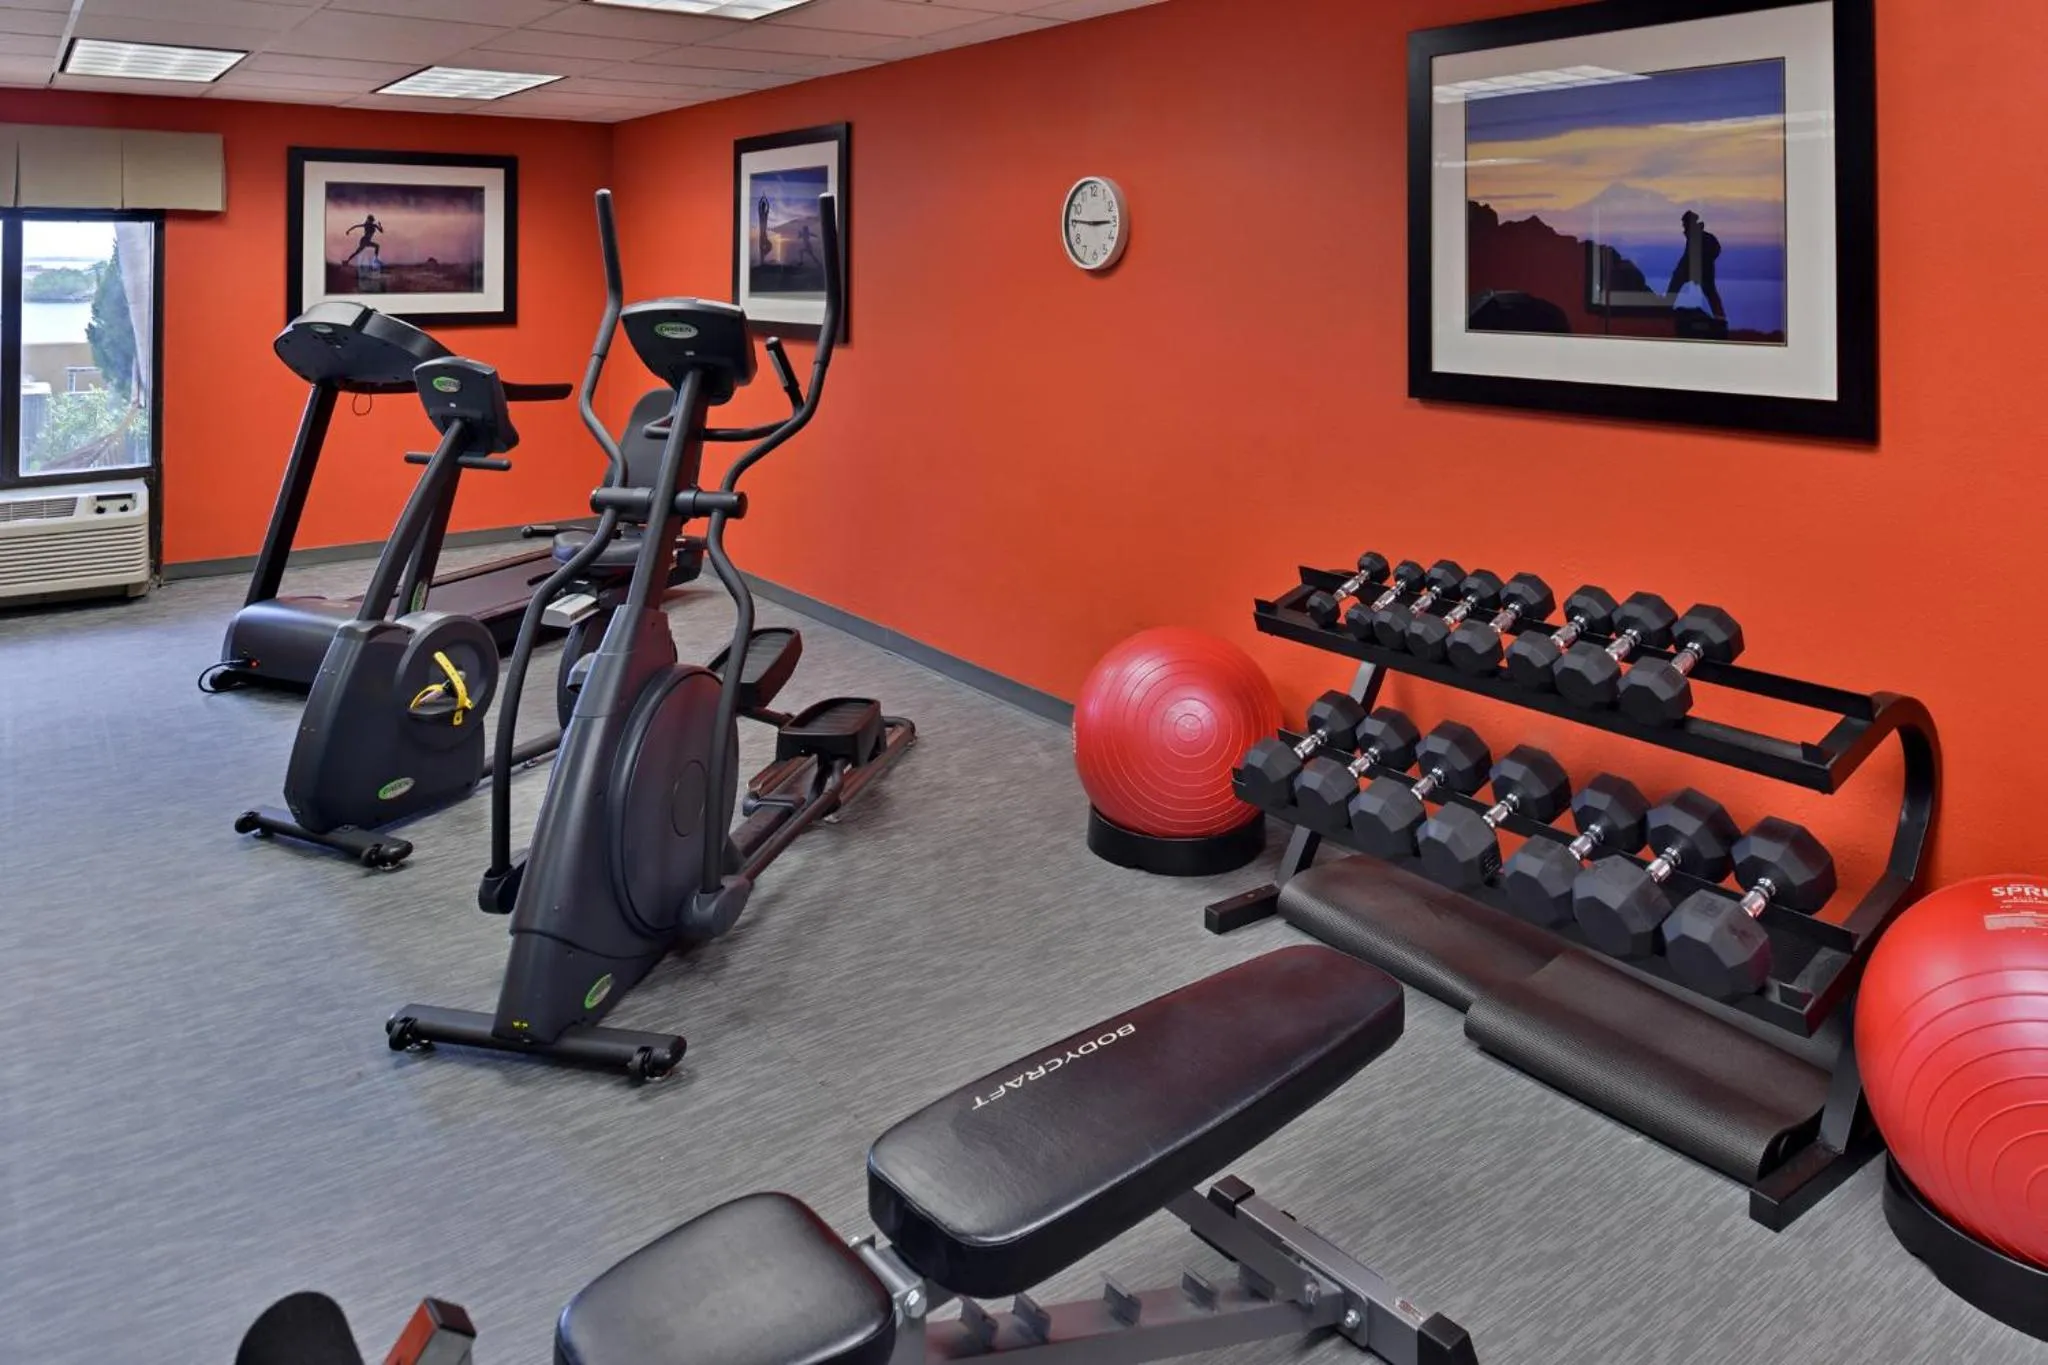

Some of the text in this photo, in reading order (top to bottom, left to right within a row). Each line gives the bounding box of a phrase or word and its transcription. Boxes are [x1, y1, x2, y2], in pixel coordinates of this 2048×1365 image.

[1080, 191, 1087, 201] 11
[1090, 185, 1097, 197] 12
[1073, 203, 1082, 215] 10
[1108, 200, 1114, 212] 2
[1112, 215, 1117, 228] 3
[1075, 233, 1081, 244] 8
[1108, 230, 1114, 241] 4
[1082, 245, 1087, 257] 7
[1102, 243, 1108, 255] 5
[1092, 251, 1098, 260] 6
[971, 1023, 1136, 1111] BODYCRAFT
